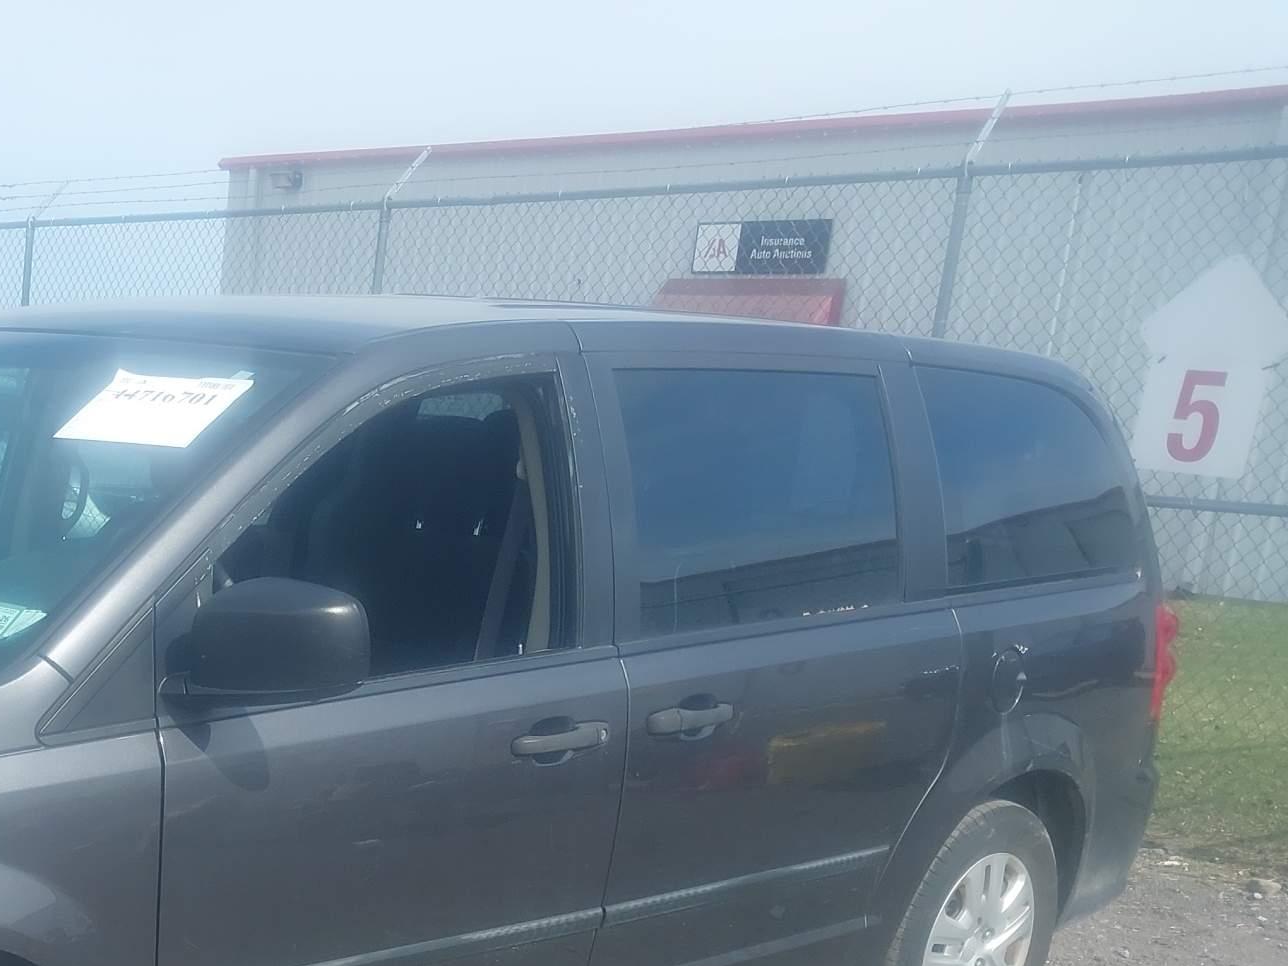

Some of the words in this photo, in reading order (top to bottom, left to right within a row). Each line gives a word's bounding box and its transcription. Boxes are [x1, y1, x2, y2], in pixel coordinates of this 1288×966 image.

[760, 235, 805, 248] Insurance
[750, 248, 771, 260] Auto
[772, 248, 812, 260] Auctions
[1166, 369, 1229, 463] 5
